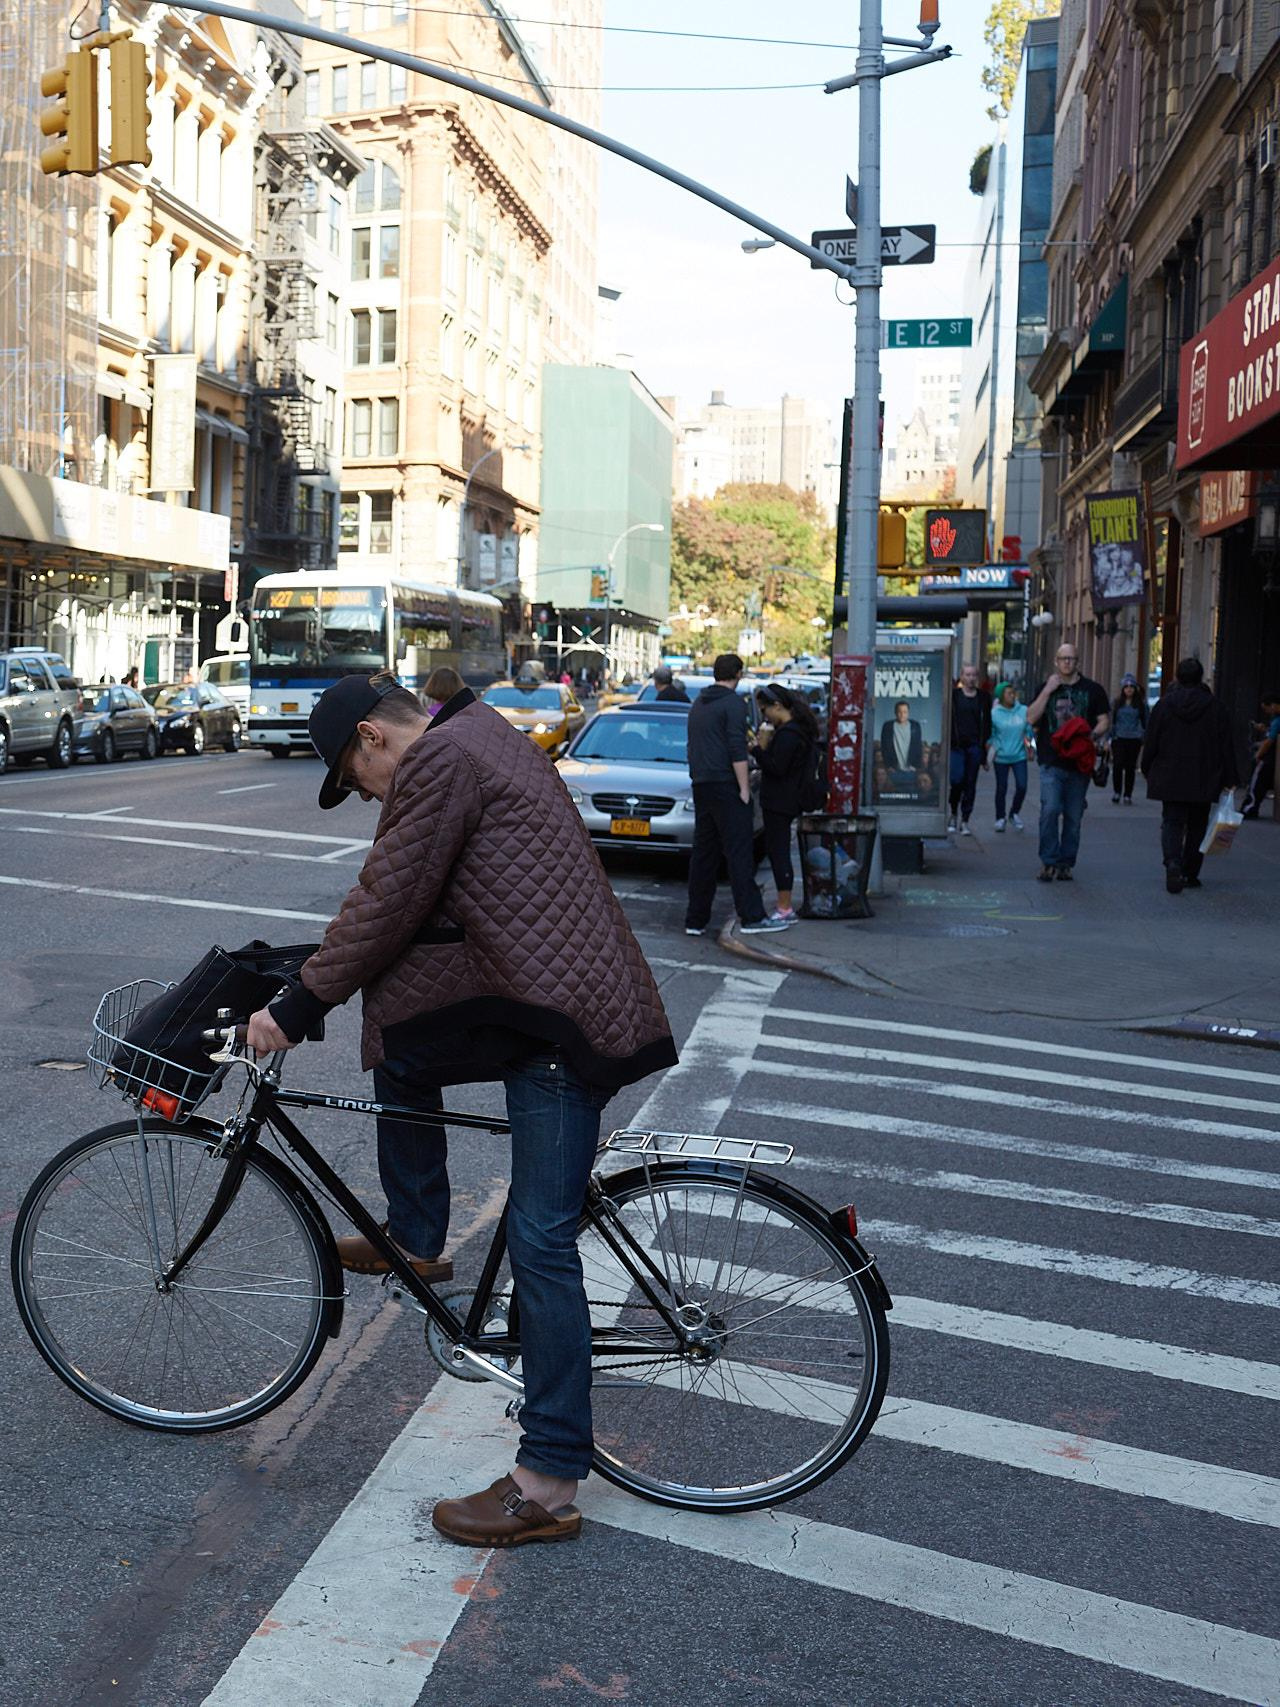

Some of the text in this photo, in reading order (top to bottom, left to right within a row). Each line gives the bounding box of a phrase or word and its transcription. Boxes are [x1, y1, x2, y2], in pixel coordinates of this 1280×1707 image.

[824, 239, 902, 257] ONE AY
[895, 321, 963, 346] E 12 ST
[1088, 496, 1138, 519] FORBIDDEN
[1090, 516, 1139, 546] PLANET
[965, 568, 1007, 584] NOW
[888, 634, 919, 644] TITAN
[875, 670, 930, 681] DELIVERY
[874, 681, 930, 698] MAN
